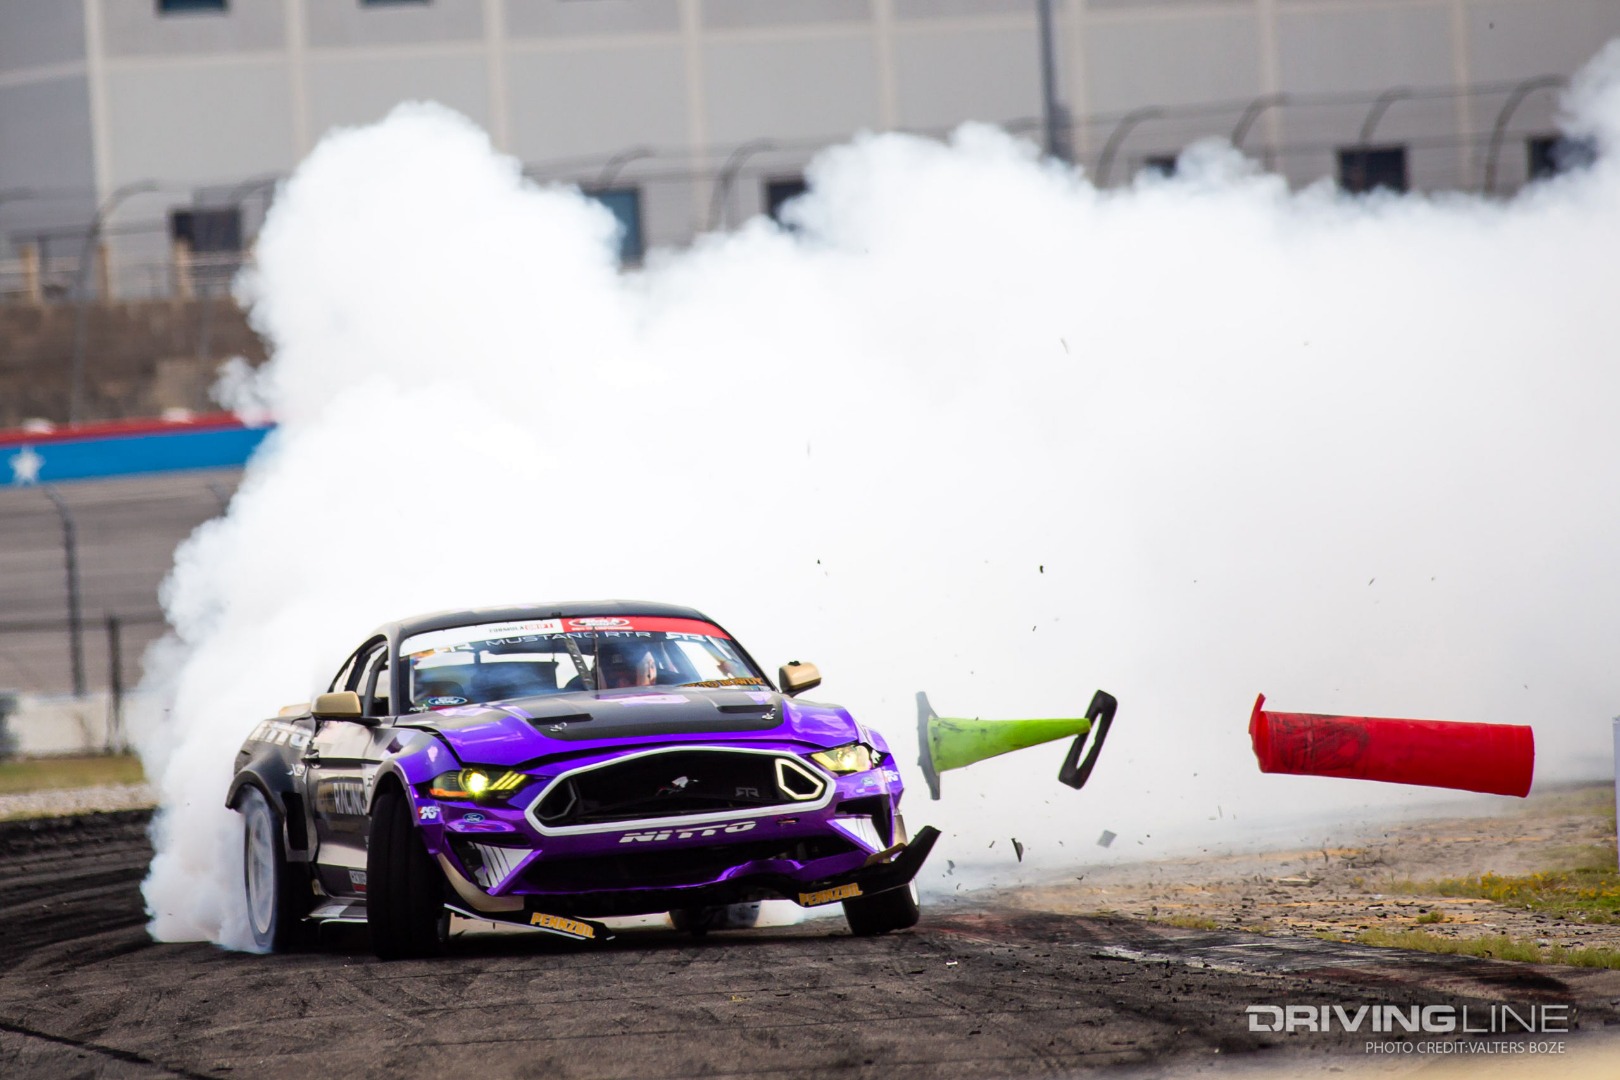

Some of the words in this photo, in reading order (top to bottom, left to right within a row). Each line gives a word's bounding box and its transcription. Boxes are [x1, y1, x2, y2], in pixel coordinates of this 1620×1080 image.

[619, 821, 757, 843] NITTO
[799, 882, 863, 906] PENNZOIL
[530, 912, 596, 939] PENNZOIL
